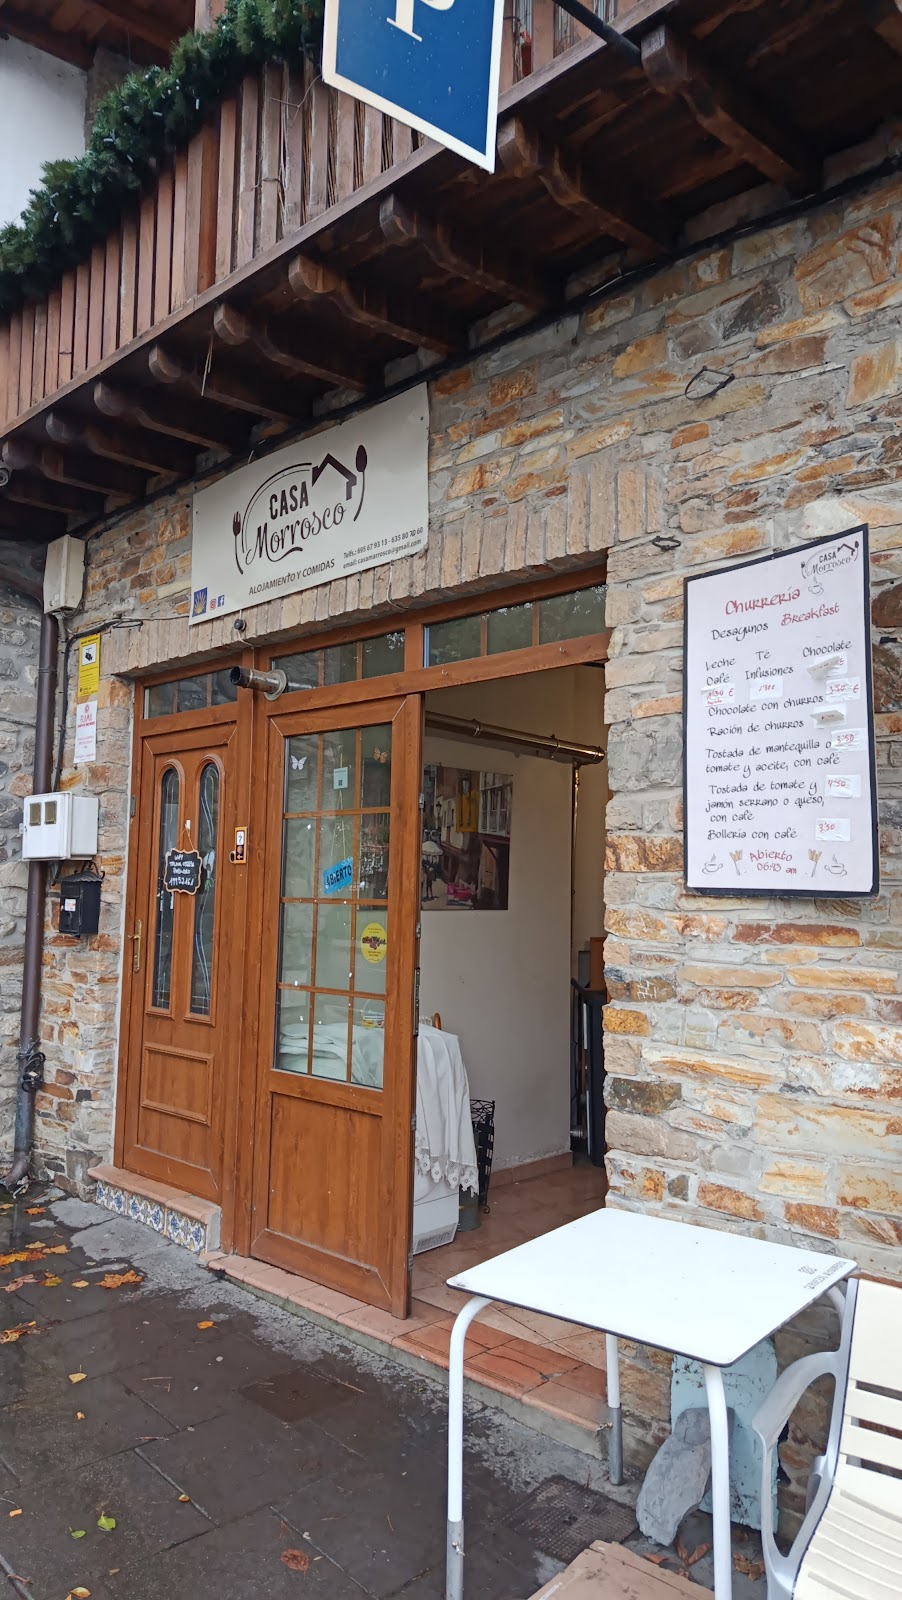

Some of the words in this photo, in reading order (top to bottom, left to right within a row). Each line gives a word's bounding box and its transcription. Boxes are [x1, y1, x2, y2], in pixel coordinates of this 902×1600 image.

[269, 481, 309, 520] CASA
[245, 502, 347, 565] Morrosco
[381, 538, 388, 546] 13
[818, 551, 837, 563] CASA
[249, 572, 296, 596] ALOJAMIENTO
[296, 570, 302, 580] Y
[302, 558, 335, 578] COMIDAS
[711, 622, 769, 642] Desayunos
[780, 602, 840, 627] Breakfast
[755, 650, 772, 661] Té
[802, 640, 853, 658] Chocolate
[705, 657, 737, 672] Leche
[706, 672, 731, 686] Café
[745, 666, 794, 681] Infusiones
[708, 702, 758, 717] Chocolate
[761, 701, 779, 711] con
[783, 695, 824, 709] churros
[707, 723, 743, 737] Ración
[747, 721, 761, 733] de
[764, 718, 804, 730] churros
[705, 748, 744, 759] Tostada
[748, 746, 761, 756] de
[765, 738, 820, 754] mantequilla
[825, 741, 832, 749] o
[705, 763, 741, 774] tomate
[742, 764, 751, 779] y
[755, 760, 789, 772] aceite,
[793, 757, 812, 768] con
[816, 753, 841, 765] café
[708, 784, 748, 795] Tostada
[752, 781, 767, 792] de
[770, 779, 806, 790] tomate
[808, 781, 818, 796] y
[705, 799, 734, 813] jamón
[738, 797, 779, 807] serrano
[794, 795, 825, 809] queso,
[710, 813, 727, 823] con
[732, 809, 755, 821] café
[707, 828, 747, 841] Bollería
[751, 831, 769, 840] con
[774, 827, 798, 839] café
[749, 849, 793, 863] Abierto
